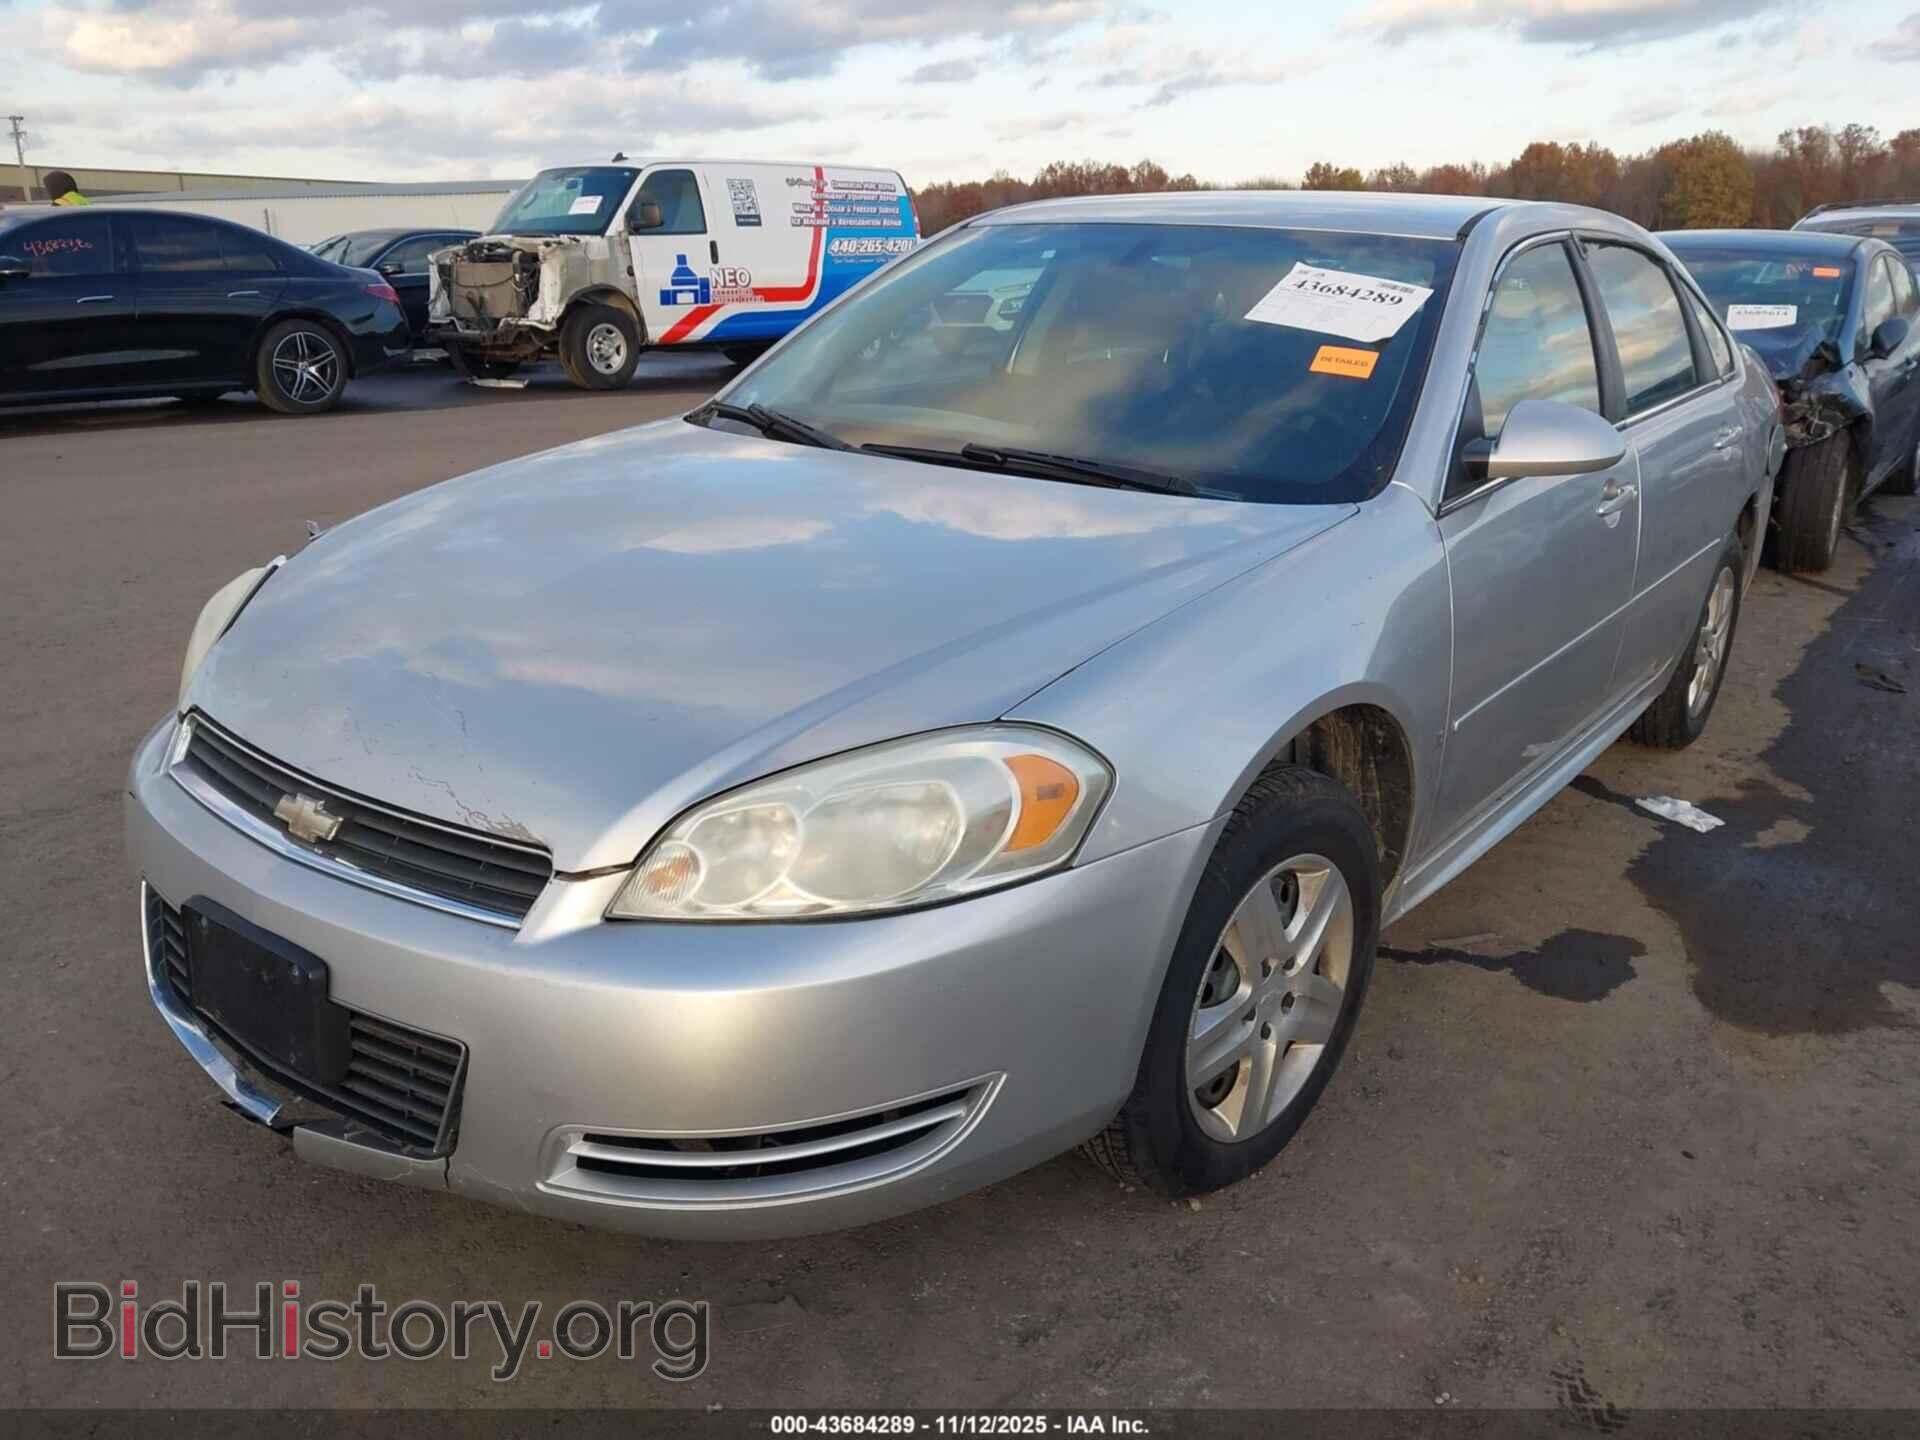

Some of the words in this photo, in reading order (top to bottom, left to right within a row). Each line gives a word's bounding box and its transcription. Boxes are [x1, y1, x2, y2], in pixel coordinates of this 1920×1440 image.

[830, 239, 913, 254] 440-265-4201
[710, 267, 752, 288] NEO
[1292, 279, 1403, 305] 43684289
[1320, 356, 1369, 367] DETAILED
